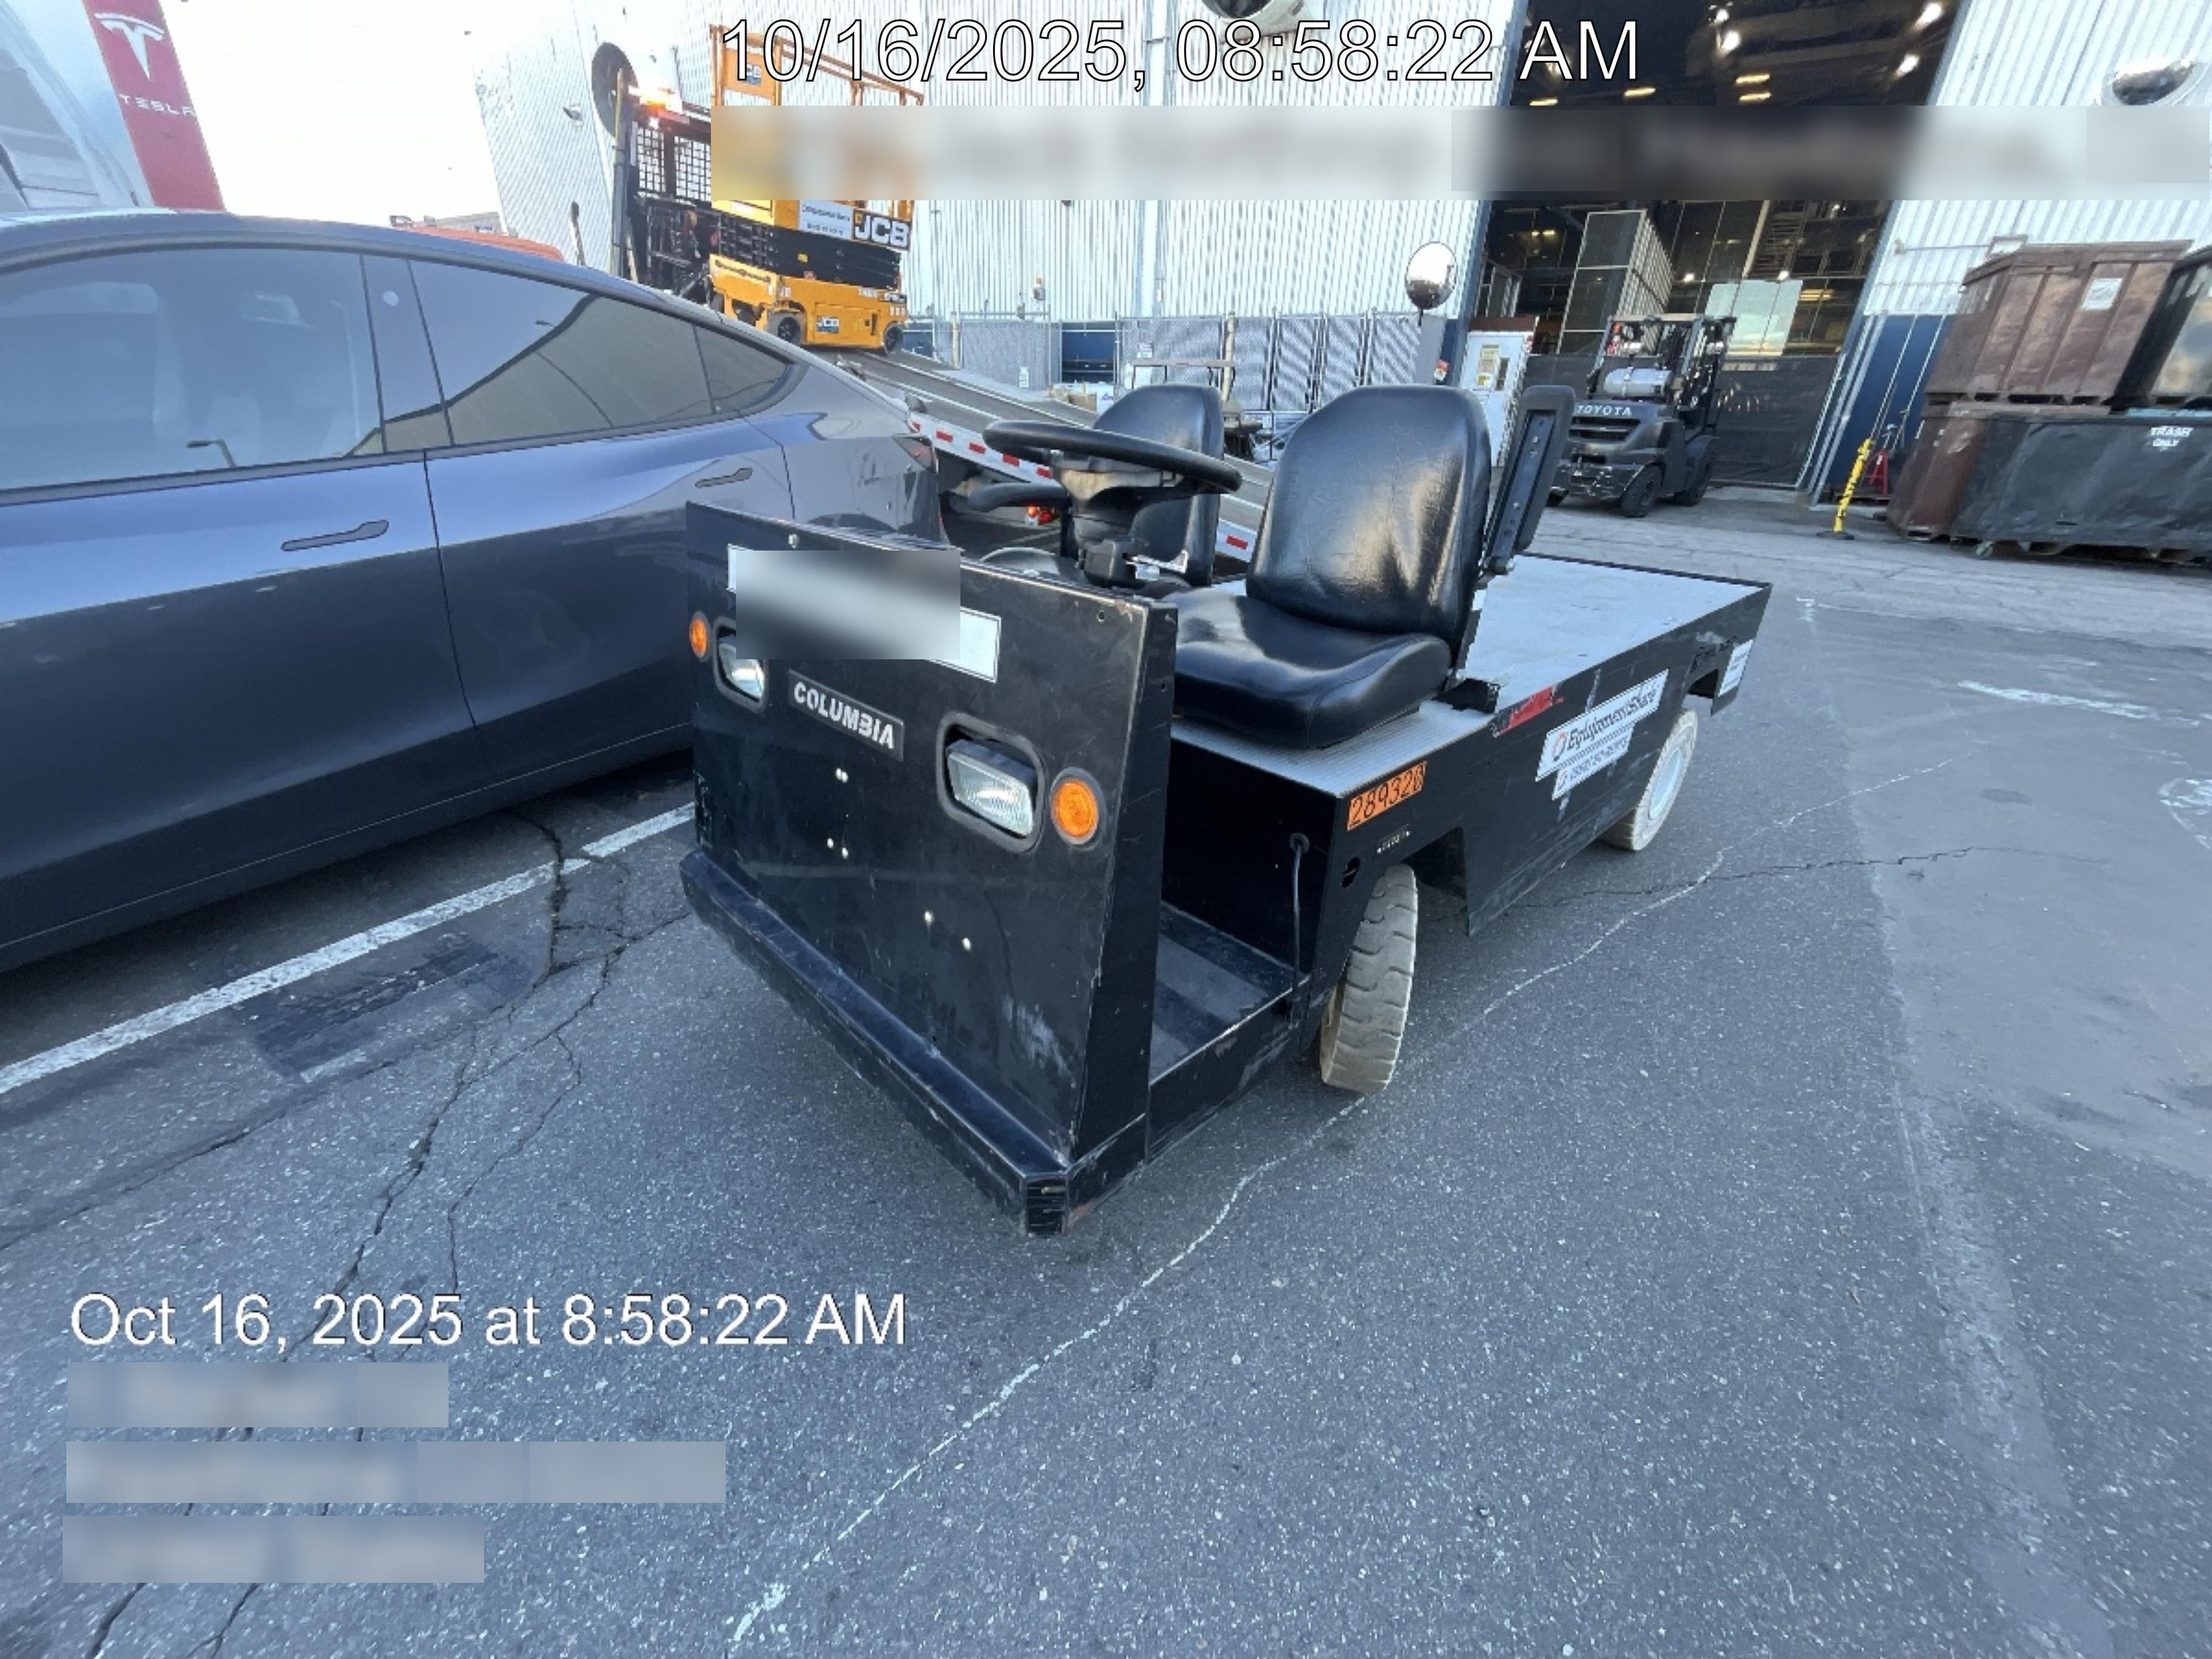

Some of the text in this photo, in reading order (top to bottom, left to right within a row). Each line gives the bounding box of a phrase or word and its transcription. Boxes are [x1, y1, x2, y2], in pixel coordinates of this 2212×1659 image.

[855, 215, 909, 248] JCB
[1577, 405, 1633, 416] TOYOTA
[794, 681, 894, 750] COLUMBIA
